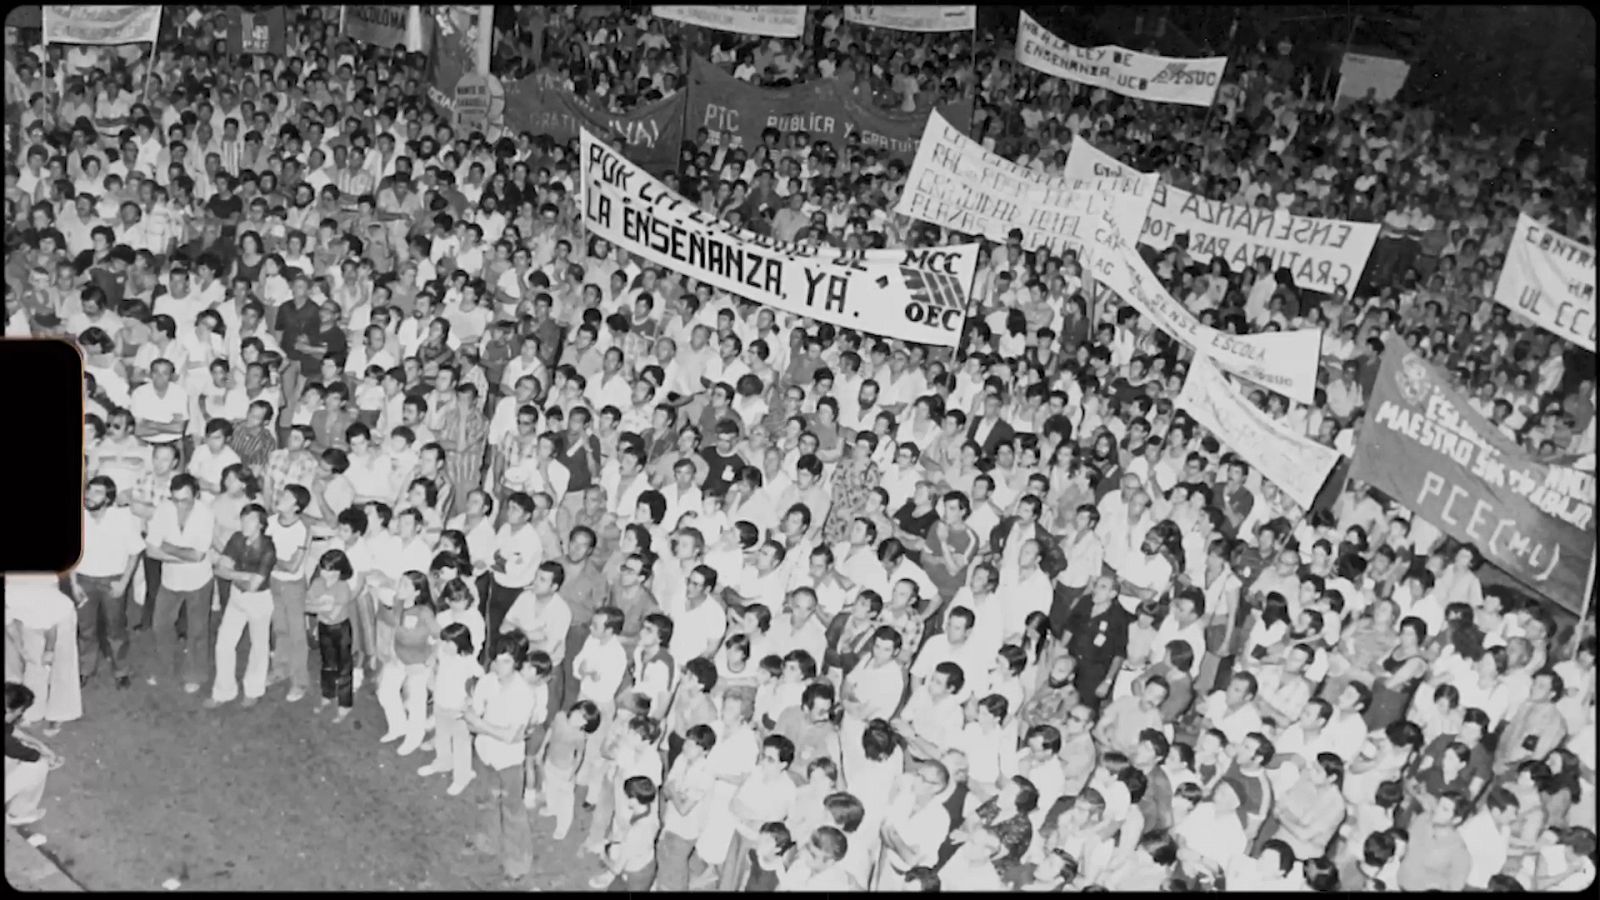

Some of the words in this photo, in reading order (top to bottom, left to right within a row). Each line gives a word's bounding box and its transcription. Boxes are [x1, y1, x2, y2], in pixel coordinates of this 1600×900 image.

[704, 103, 740, 132] PTC
[587, 187, 611, 229] LA
[803, 265, 860, 319] YA.
[898, 249, 962, 275] MCC
[904, 302, 961, 331] OEC
[1374, 400, 1475, 468] MAESTRO
